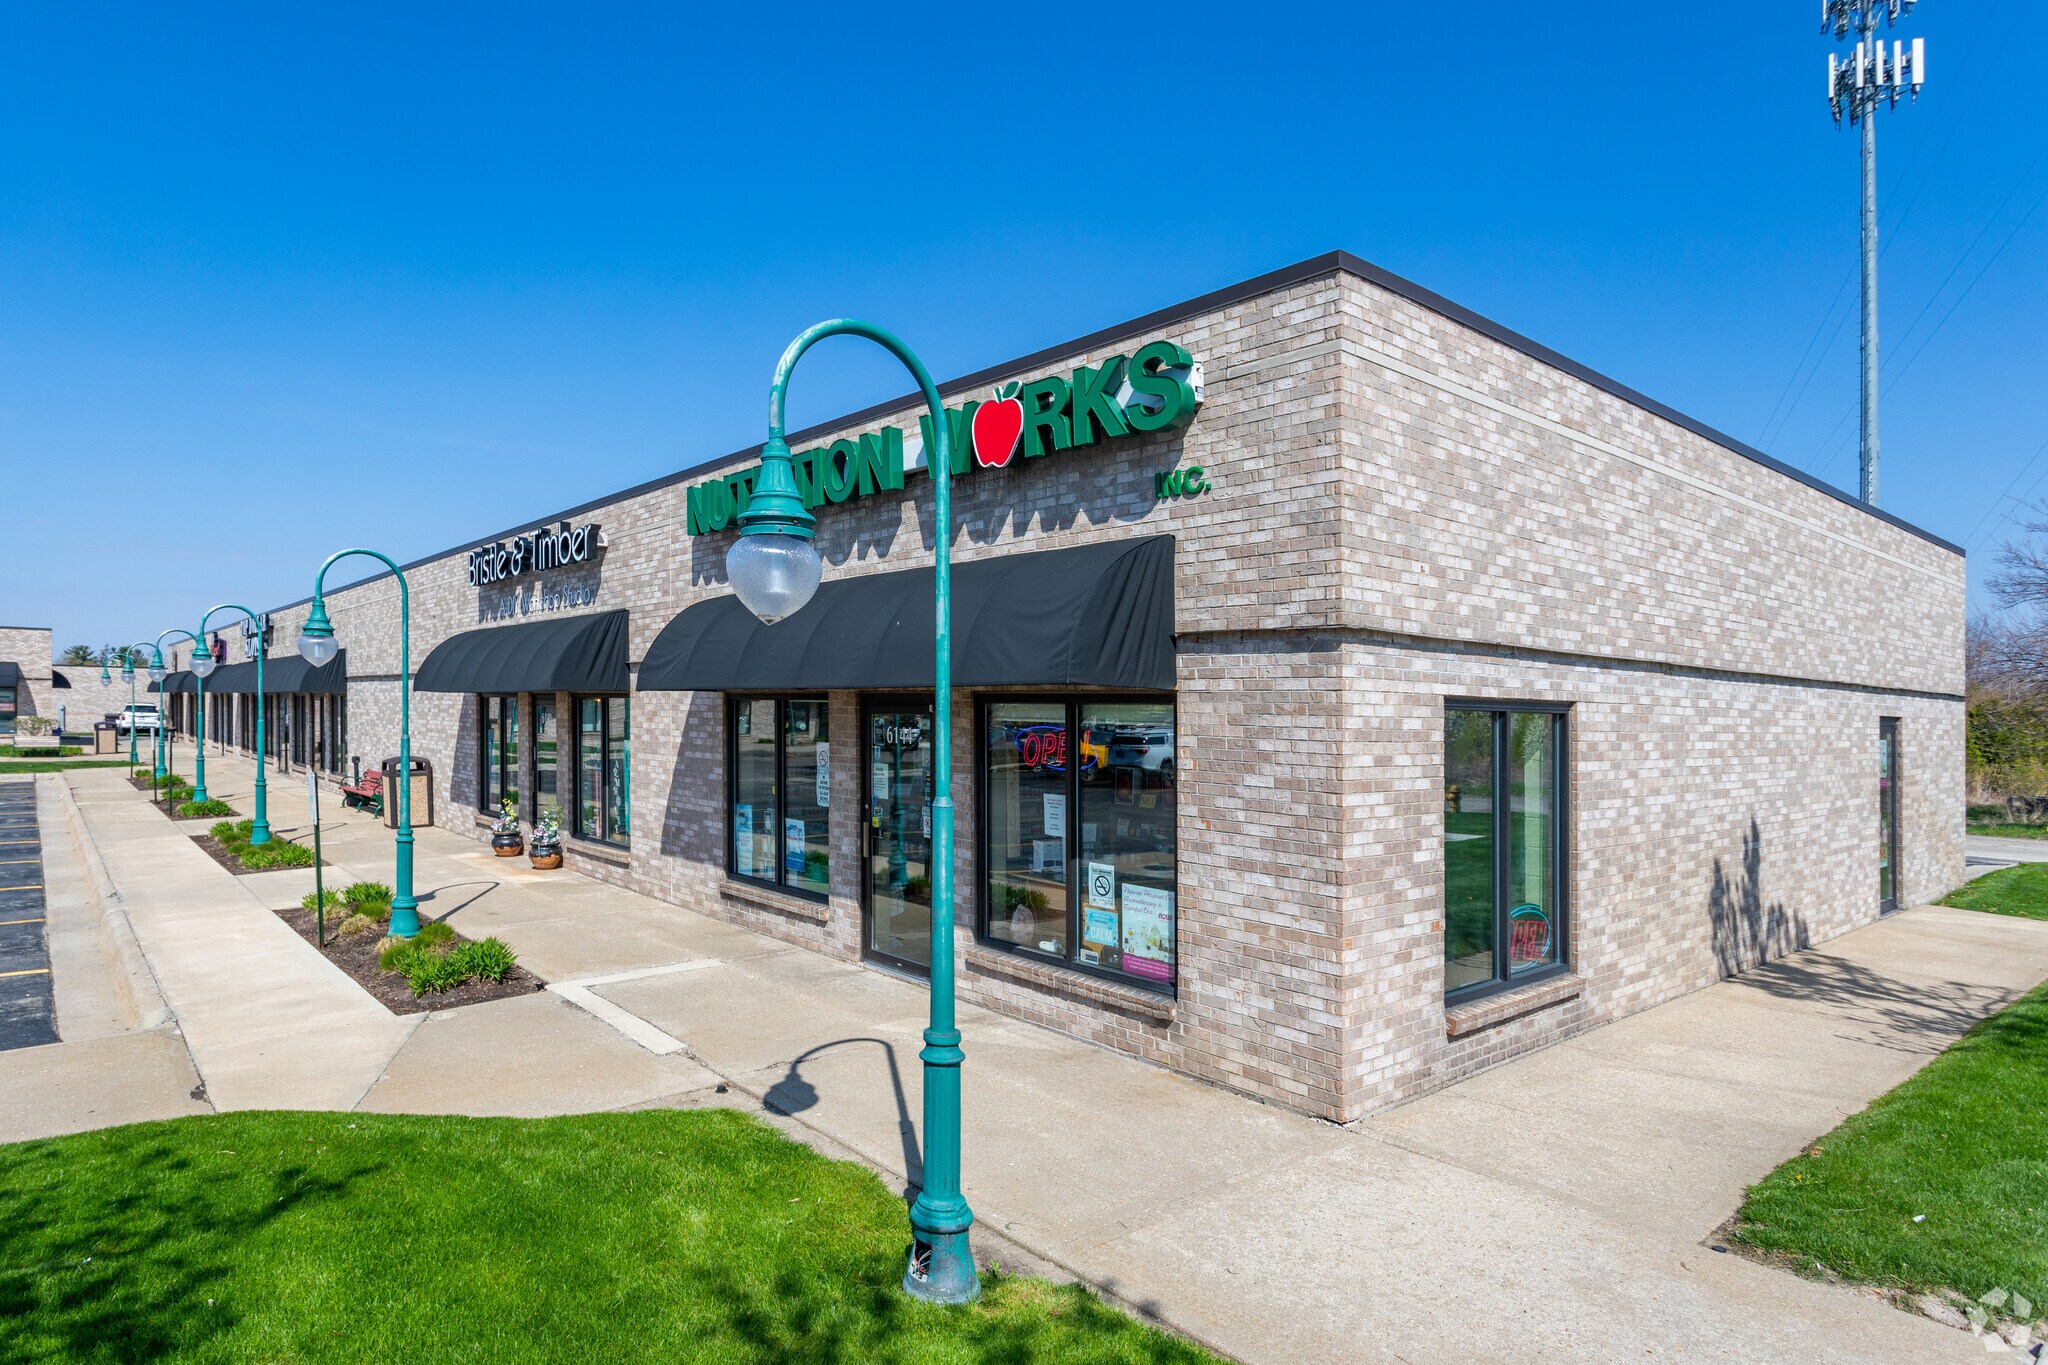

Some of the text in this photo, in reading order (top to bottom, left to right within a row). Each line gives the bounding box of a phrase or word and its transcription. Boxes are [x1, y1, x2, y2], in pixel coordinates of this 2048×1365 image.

[687, 426, 904, 536] NUTTION
[1155, 466, 1212, 498] INC.
[468, 521, 597, 587] Bristle & Timber
[563, 582, 590, 606] Studio
[886, 726, 912, 744] 6144
[1090, 926, 1113, 943] CALM
[1510, 919, 1547, 961] PEN
